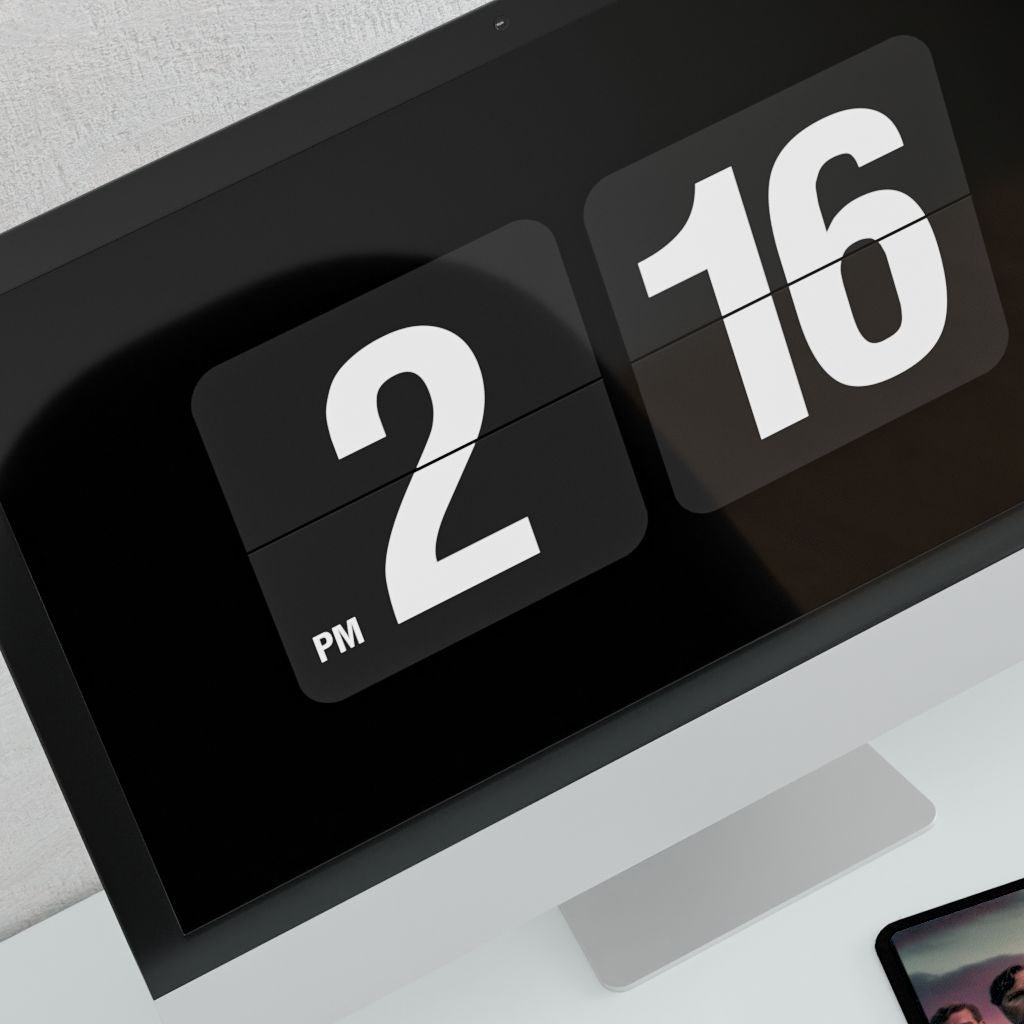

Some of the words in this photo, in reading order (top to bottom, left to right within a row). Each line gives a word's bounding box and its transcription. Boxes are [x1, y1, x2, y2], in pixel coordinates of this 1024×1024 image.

[637, 107, 949, 440] 16
[324, 325, 541, 625] 2
[311, 616, 365, 664] PM
